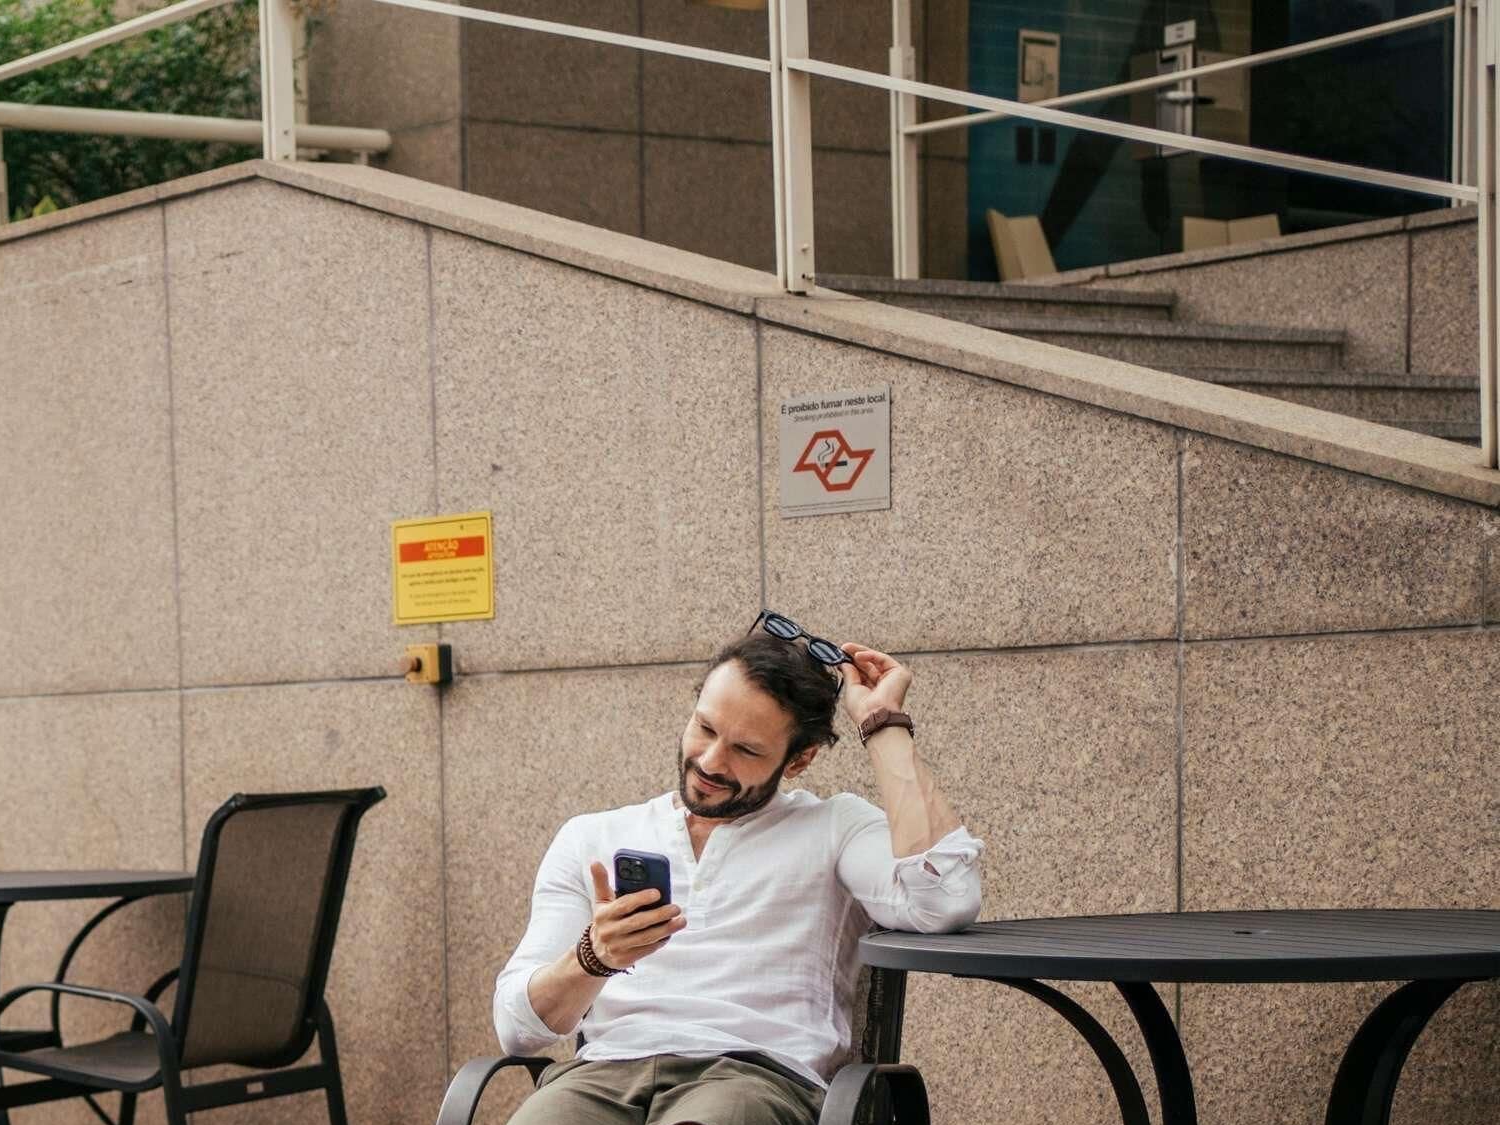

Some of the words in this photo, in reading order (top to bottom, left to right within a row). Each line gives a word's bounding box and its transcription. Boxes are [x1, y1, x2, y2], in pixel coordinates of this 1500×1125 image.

[788, 401, 819, 415] proibido
[821, 400, 843, 409] fumar
[844, 397, 865, 406] neste
[424, 538, 459, 552] ATENÇÃO
